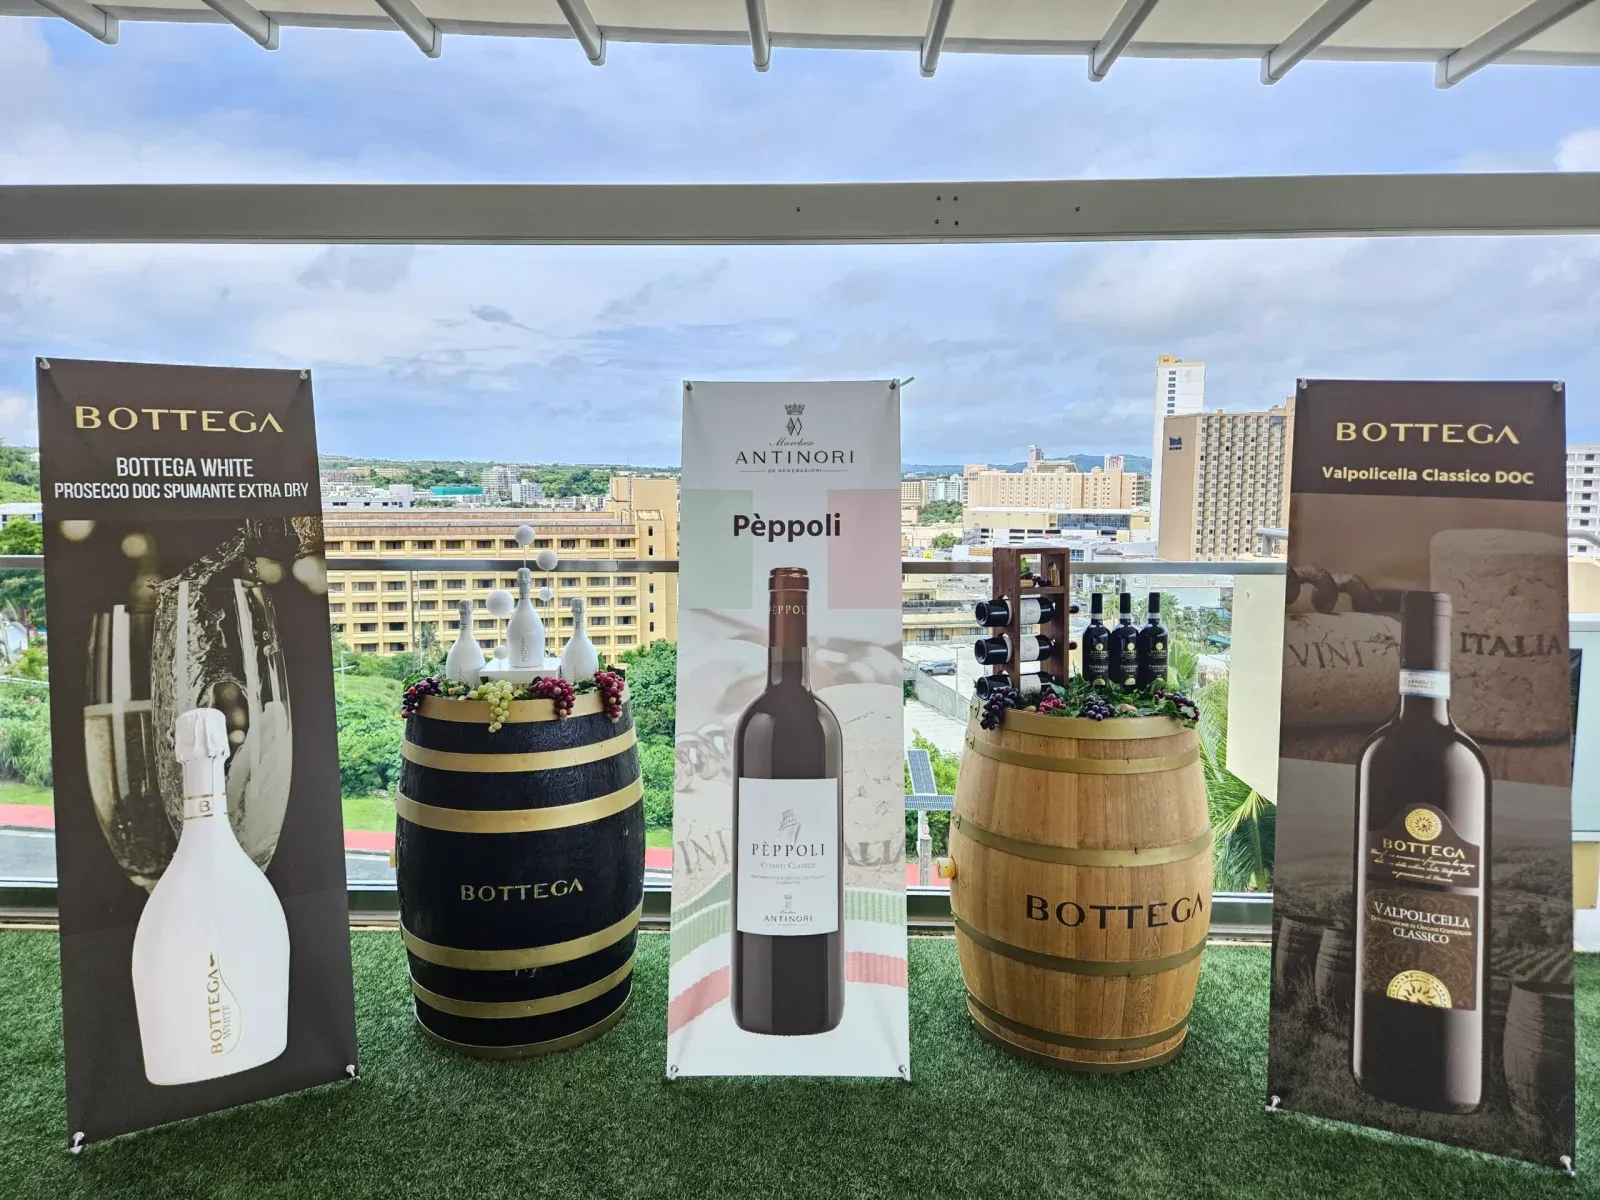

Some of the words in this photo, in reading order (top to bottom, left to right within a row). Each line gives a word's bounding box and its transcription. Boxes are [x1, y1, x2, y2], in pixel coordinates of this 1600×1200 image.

[76, 406, 284, 433] BOTTEGA
[769, 437, 816, 447] Marchesi
[1336, 422, 1520, 444] BOTTEGA
[116, 457, 196, 477] BOTTEGA
[200, 458, 254, 477] WHITE
[735, 450, 854, 464] ANTINORI
[1322, 466, 1418, 482] Valpolicella
[1422, 469, 1490, 483] Classico
[1495, 471, 1534, 484] DOC
[54, 483, 130, 499] PROSECCO
[132, 483, 160, 499] DOC
[164, 483, 236, 498] SPUMANTE
[239, 483, 281, 498] EXTRA
[284, 482, 309, 498] DRY
[734, 513, 840, 542] Pèppoli
[1288, 640, 1364, 668] VINI
[1460, 632, 1562, 658] ITALIA
[200, 800, 211, 812] B
[752, 841, 825, 857] PÈPPOLI
[1383, 838, 1465, 859] BOTTEGA
[460, 878, 584, 902] BOTTEGA
[764, 915, 813, 923] ANTINORI
[1026, 892, 1202, 930] BOTTEGA
[1374, 902, 1470, 928] VALPOLICELLA
[1392, 927, 1449, 944] CLASSICO
[206, 969, 224, 1054] BOTTEGA
[222, 1004, 232, 1040] WHITE
